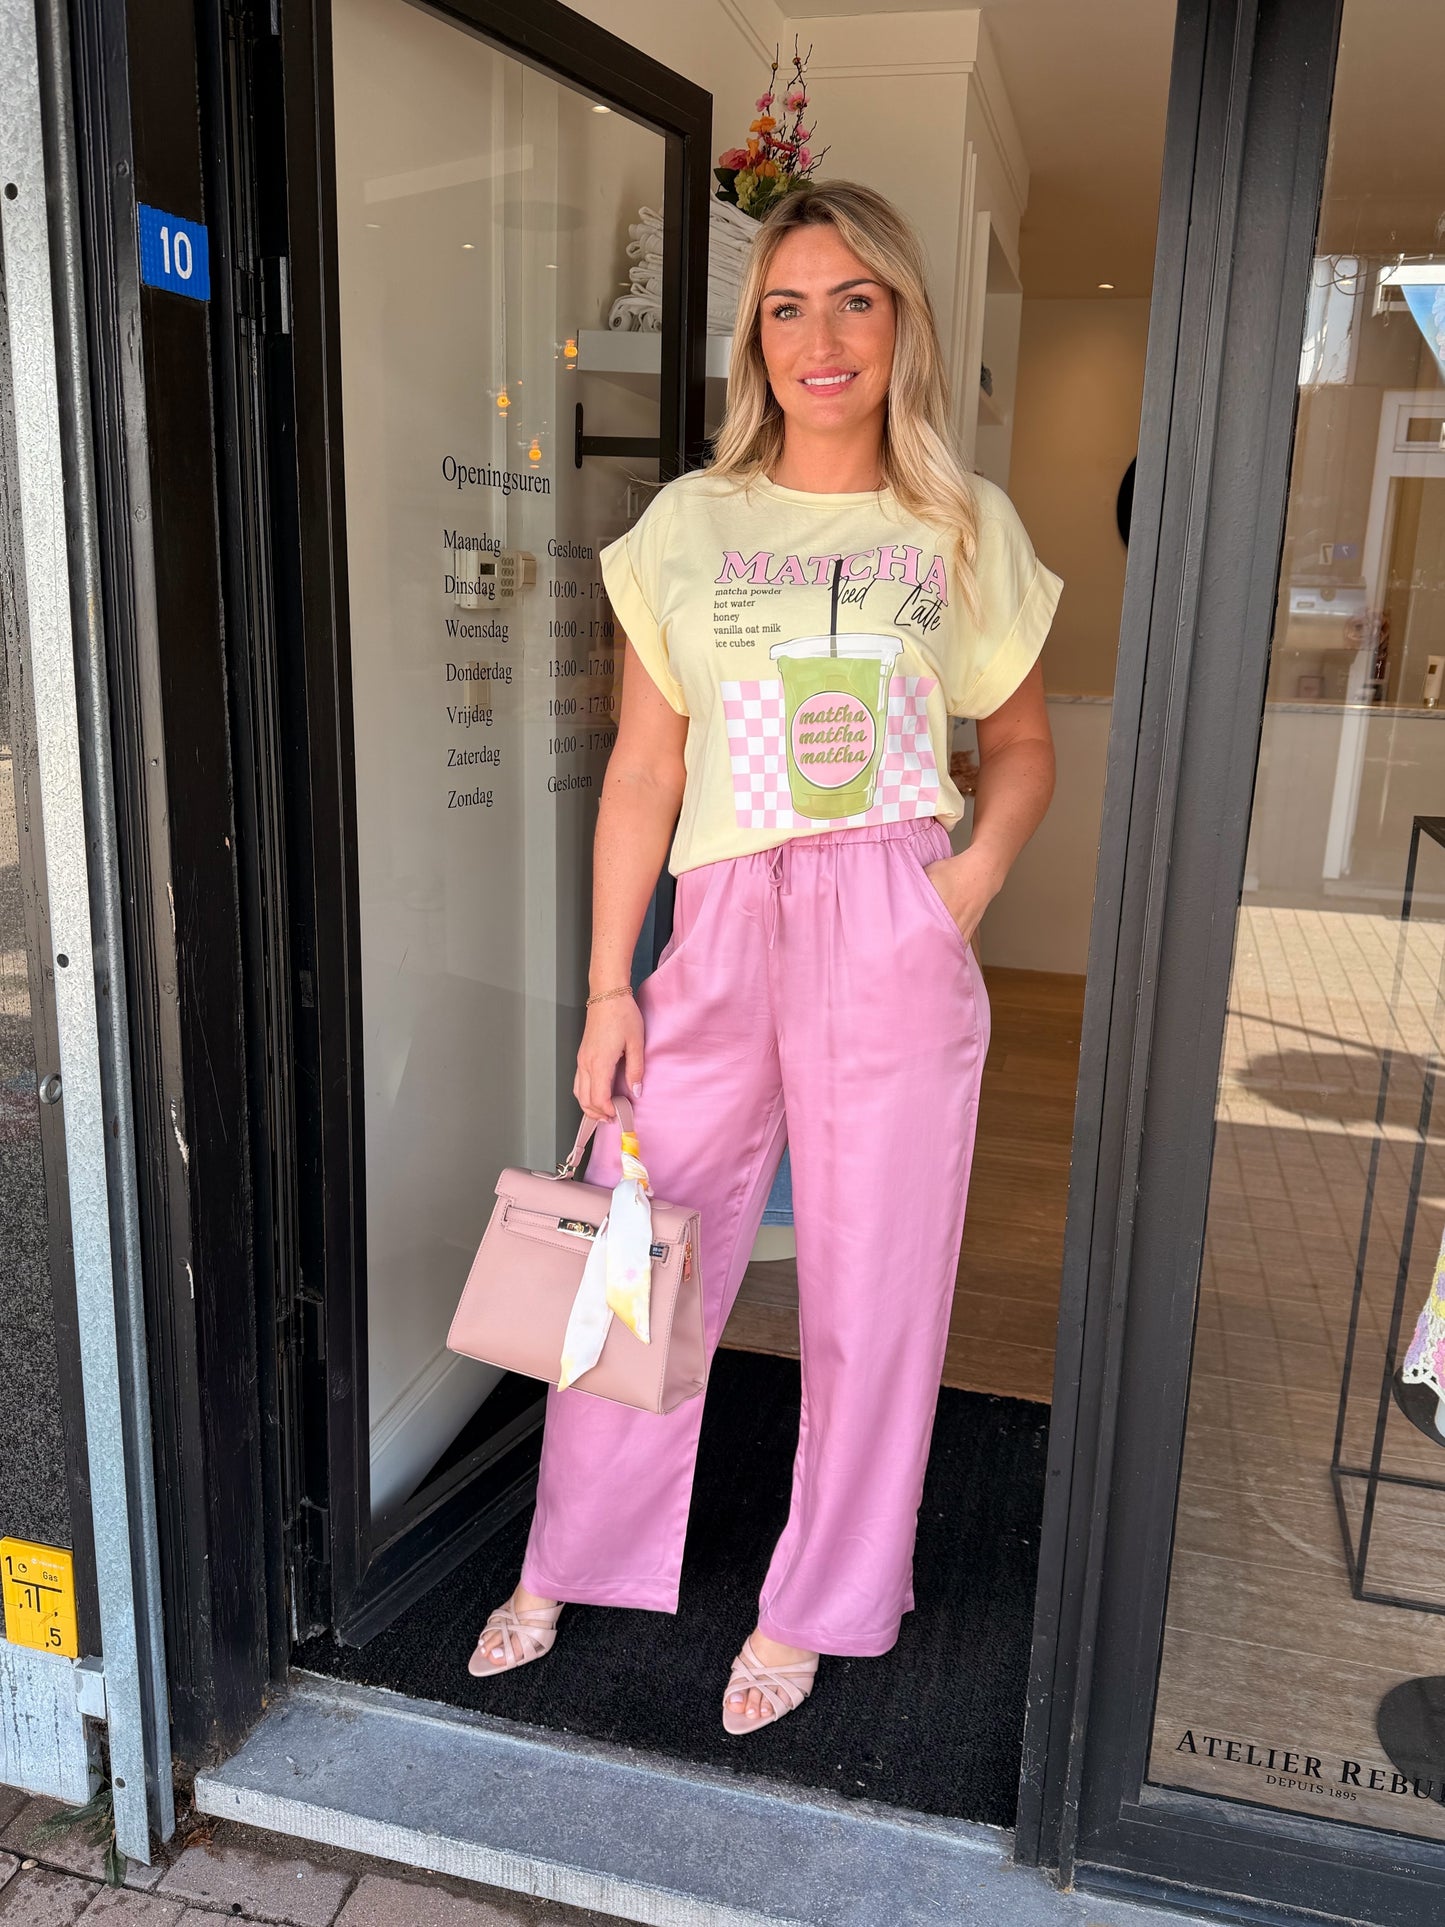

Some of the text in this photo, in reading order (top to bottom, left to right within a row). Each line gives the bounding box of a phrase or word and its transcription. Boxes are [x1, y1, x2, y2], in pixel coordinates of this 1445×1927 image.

[160, 226, 193, 280] 10
[442, 455, 551, 495] Openingsuren
[443, 529, 593, 560] Maandag Gesloten
[444, 575, 496, 600] Dinsdag
[549, 580, 577, 598] 10:00
[589, 582, 610, 600] 17:
[714, 544, 949, 607] MATCHA
[715, 587, 782, 596] matcha powder
[713, 612, 740, 622] honey
[714, 600, 756, 609] hot water
[894, 583, 943, 635] Latte
[445, 619, 509, 643] Woensdag
[549, 621, 577, 638] 10:00
[589, 621, 615, 638] 17:00
[713, 623, 781, 634] vanilla oat milk
[715, 638, 756, 648] ice cubes
[445, 662, 513, 685] Donderdag
[549, 659, 577, 678] 13:00
[588, 659, 615, 676] 17:00
[446, 704, 494, 729] Vrijdag
[549, 698, 577, 716] 10:00
[588, 695, 615, 713] 17:00
[799, 704, 867, 725] matcha
[799, 724, 868, 744] matcha
[447, 745, 501, 767] Zaterdag
[549, 735, 577, 755] 10:00
[589, 732, 616, 751] 17:00
[800, 744, 868, 764] matcha
[447, 773, 593, 809] Zondag Gesloten
[5, 1555, 13, 1576] 1
[43, 1571, 59, 1582] Gas
[1175, 1729, 1445, 1802] ATELIER REBU
[1266, 1774, 1357, 1801] DEPUIS 1895
